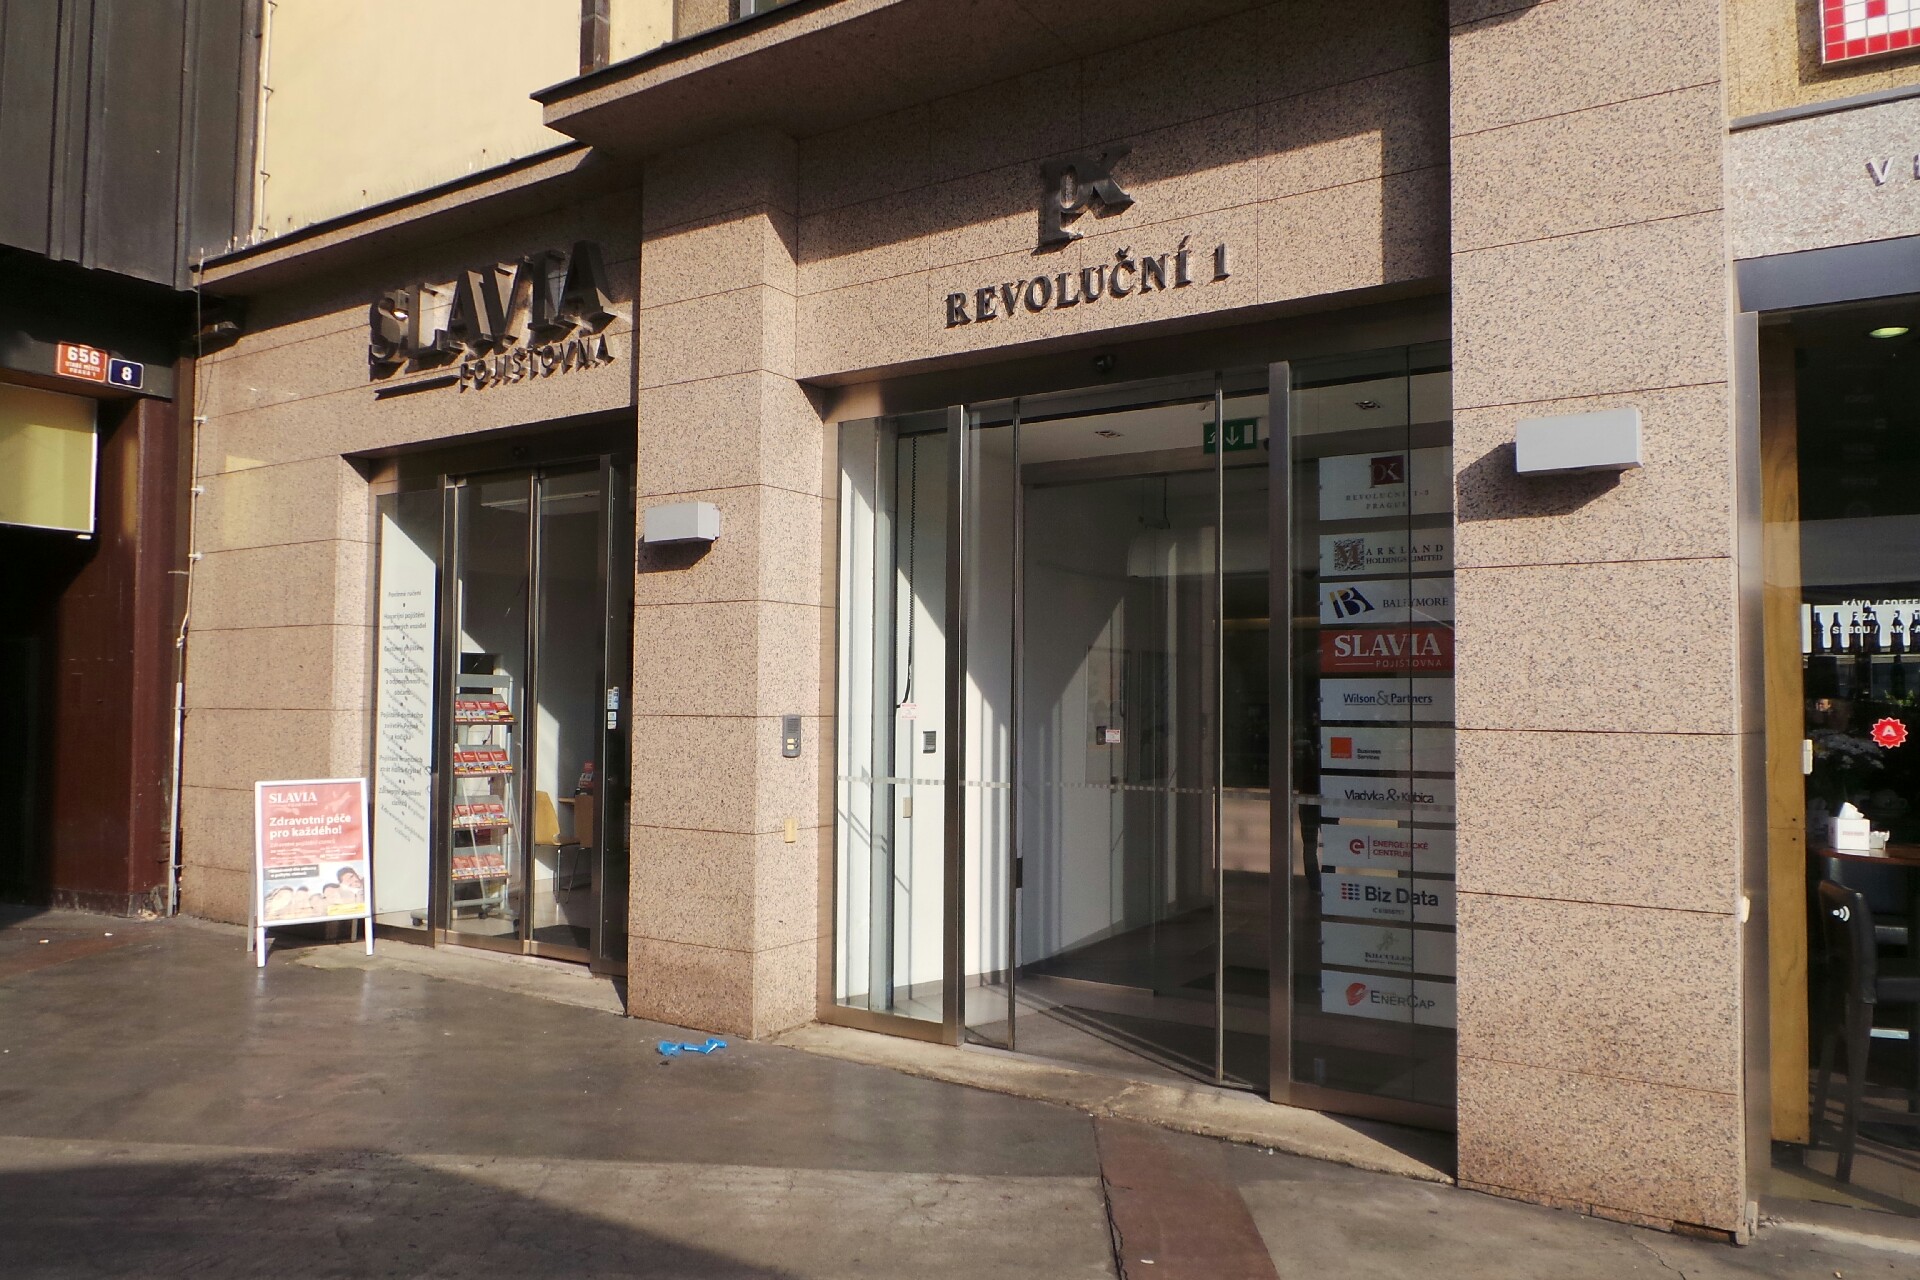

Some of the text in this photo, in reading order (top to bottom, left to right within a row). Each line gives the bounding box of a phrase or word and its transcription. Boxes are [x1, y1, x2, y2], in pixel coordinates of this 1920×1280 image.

[944, 235, 1230, 329] REVOLUČNÍ 1
[369, 240, 619, 366] SLAVIA
[67, 346, 101, 366] 656
[121, 366, 132, 381] 8
[1334, 633, 1442, 657] SLAVIA
[268, 792, 318, 804] SLAVIA
[269, 813, 352, 827] Zdravotní péče
[269, 824, 342, 840] pro každého!
[1364, 885, 1439, 906] Biz Data
